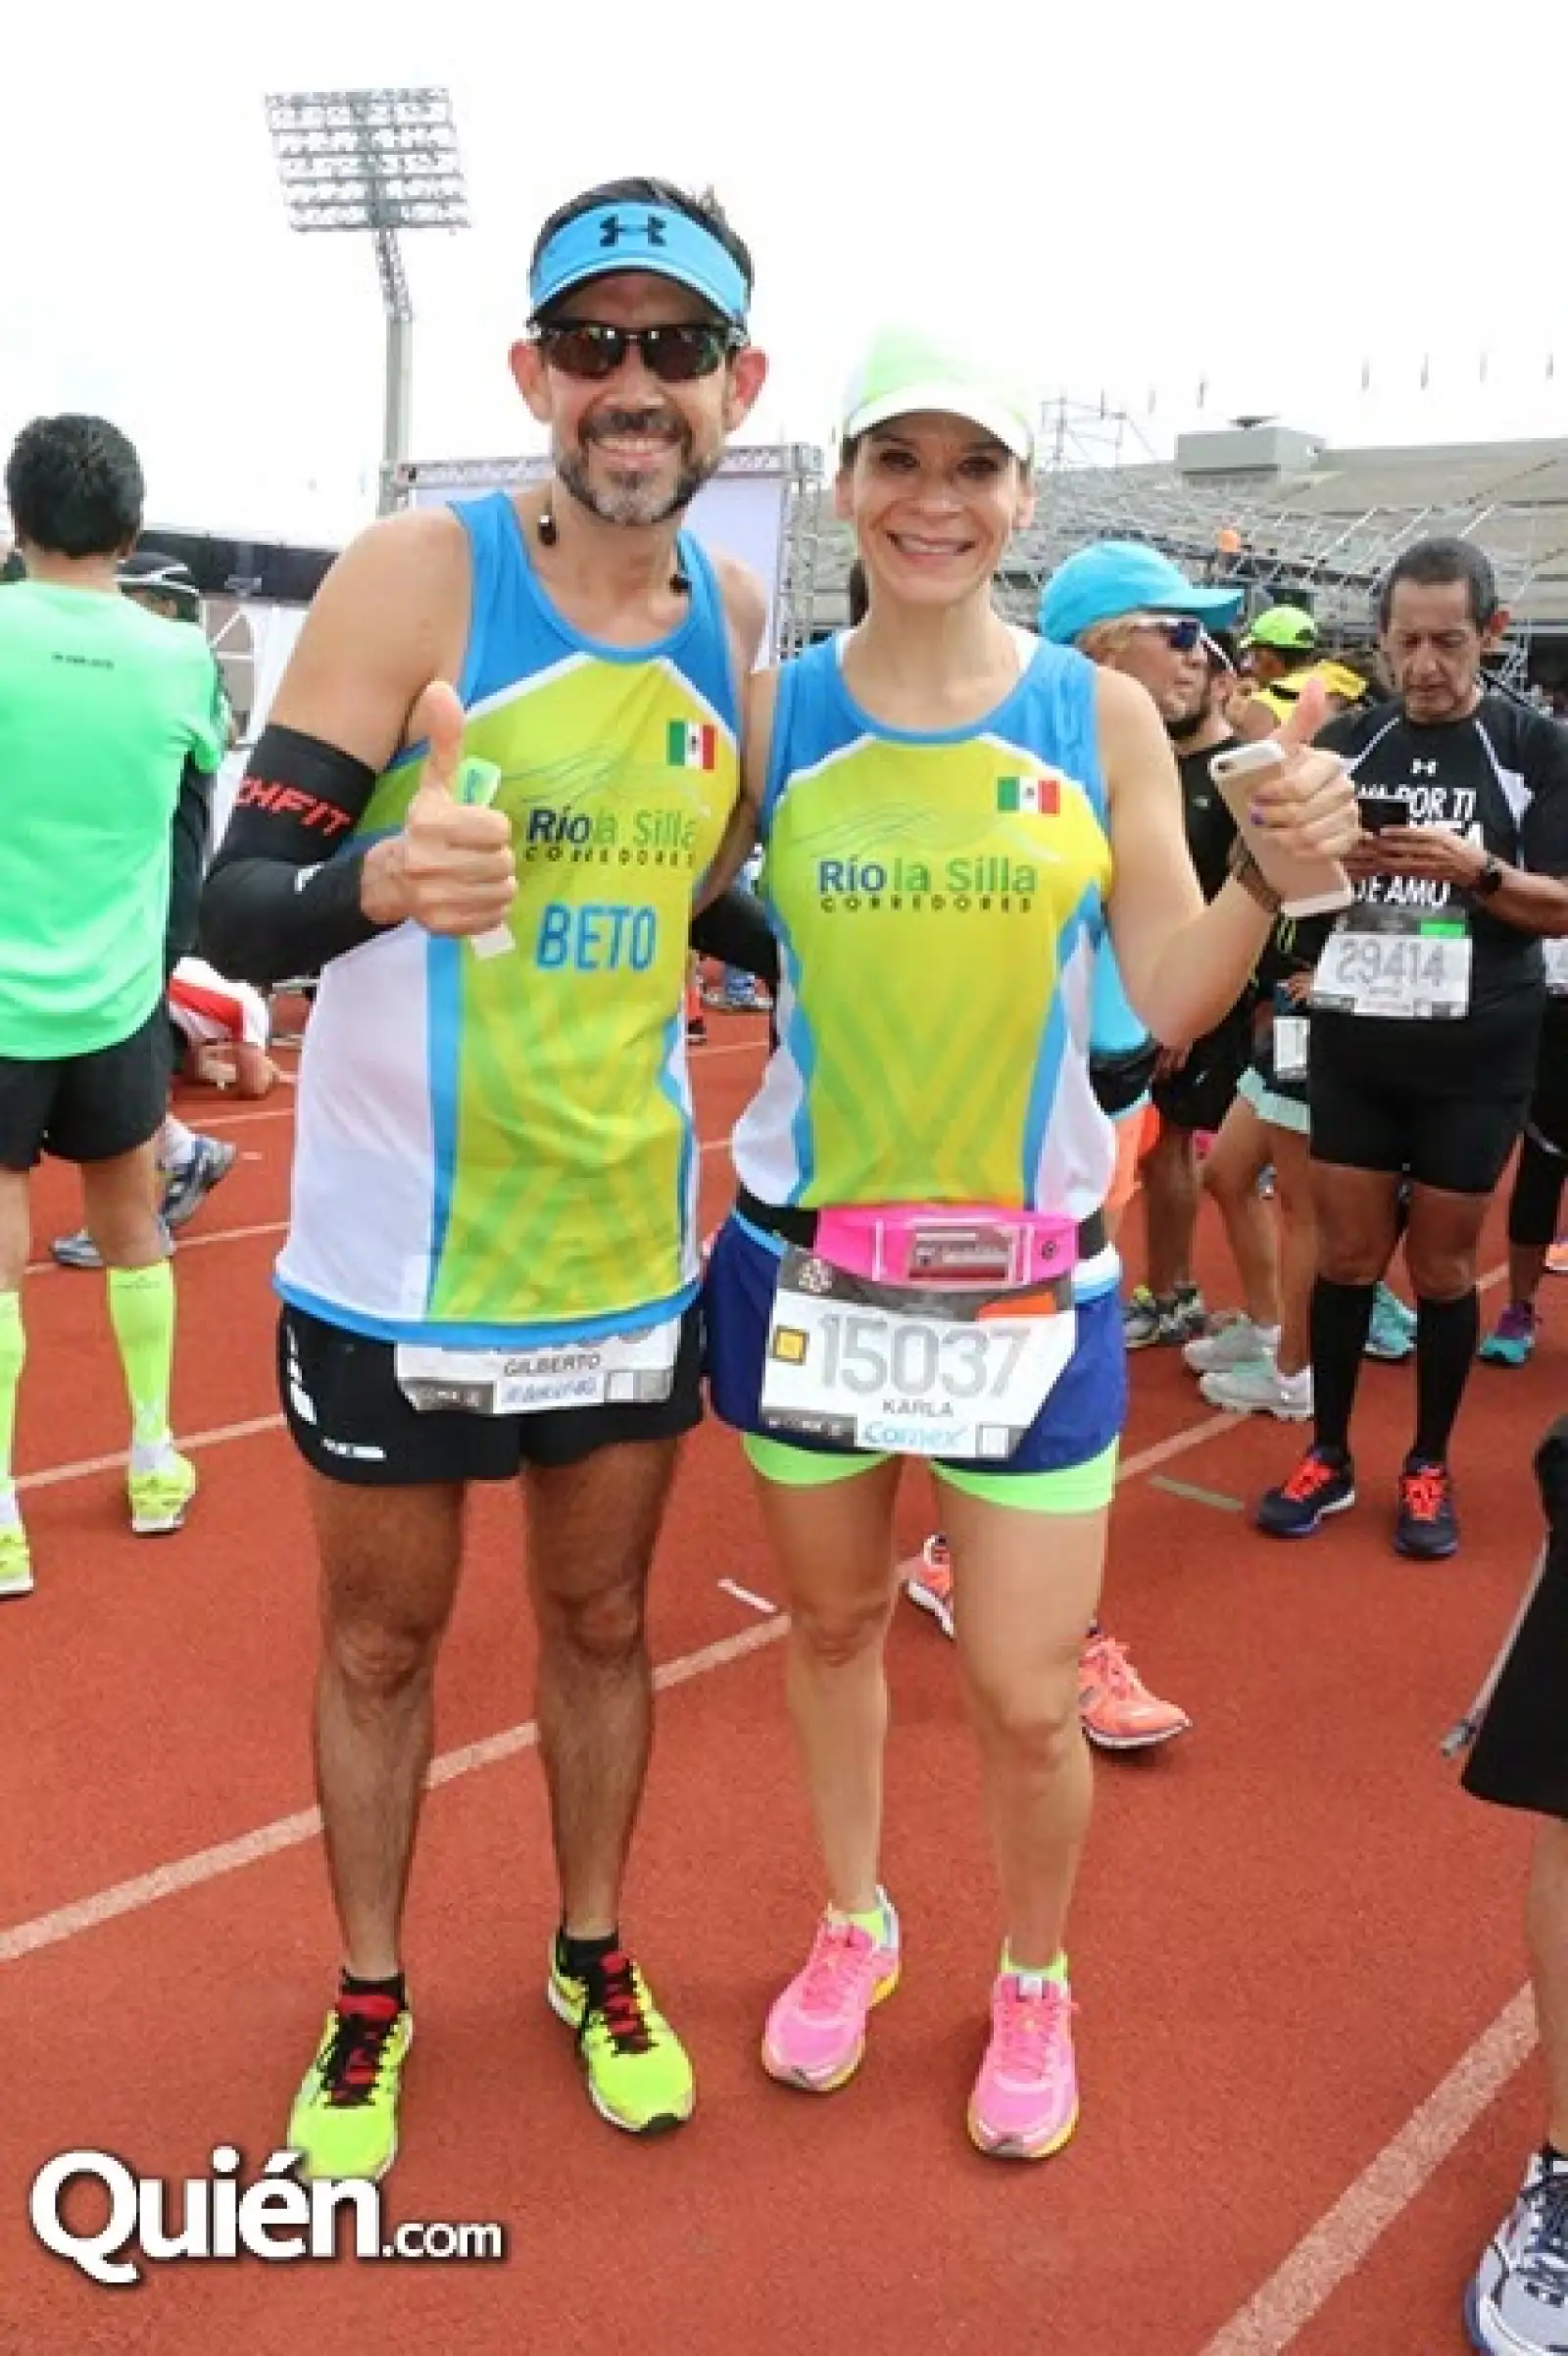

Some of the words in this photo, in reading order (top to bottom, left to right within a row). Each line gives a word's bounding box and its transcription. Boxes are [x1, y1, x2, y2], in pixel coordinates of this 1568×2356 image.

[633, 809, 697, 847] Silla
[819, 854, 887, 893] Río
[893, 857, 930, 893] la
[945, 857, 1038, 894] Silla
[536, 903, 657, 971] BETO
[1336, 937, 1446, 986] 29414
[504, 1352, 602, 1377] GILBERTO
[817, 1312, 1031, 1399] 15037
[882, 1398, 956, 1418] KARLA
